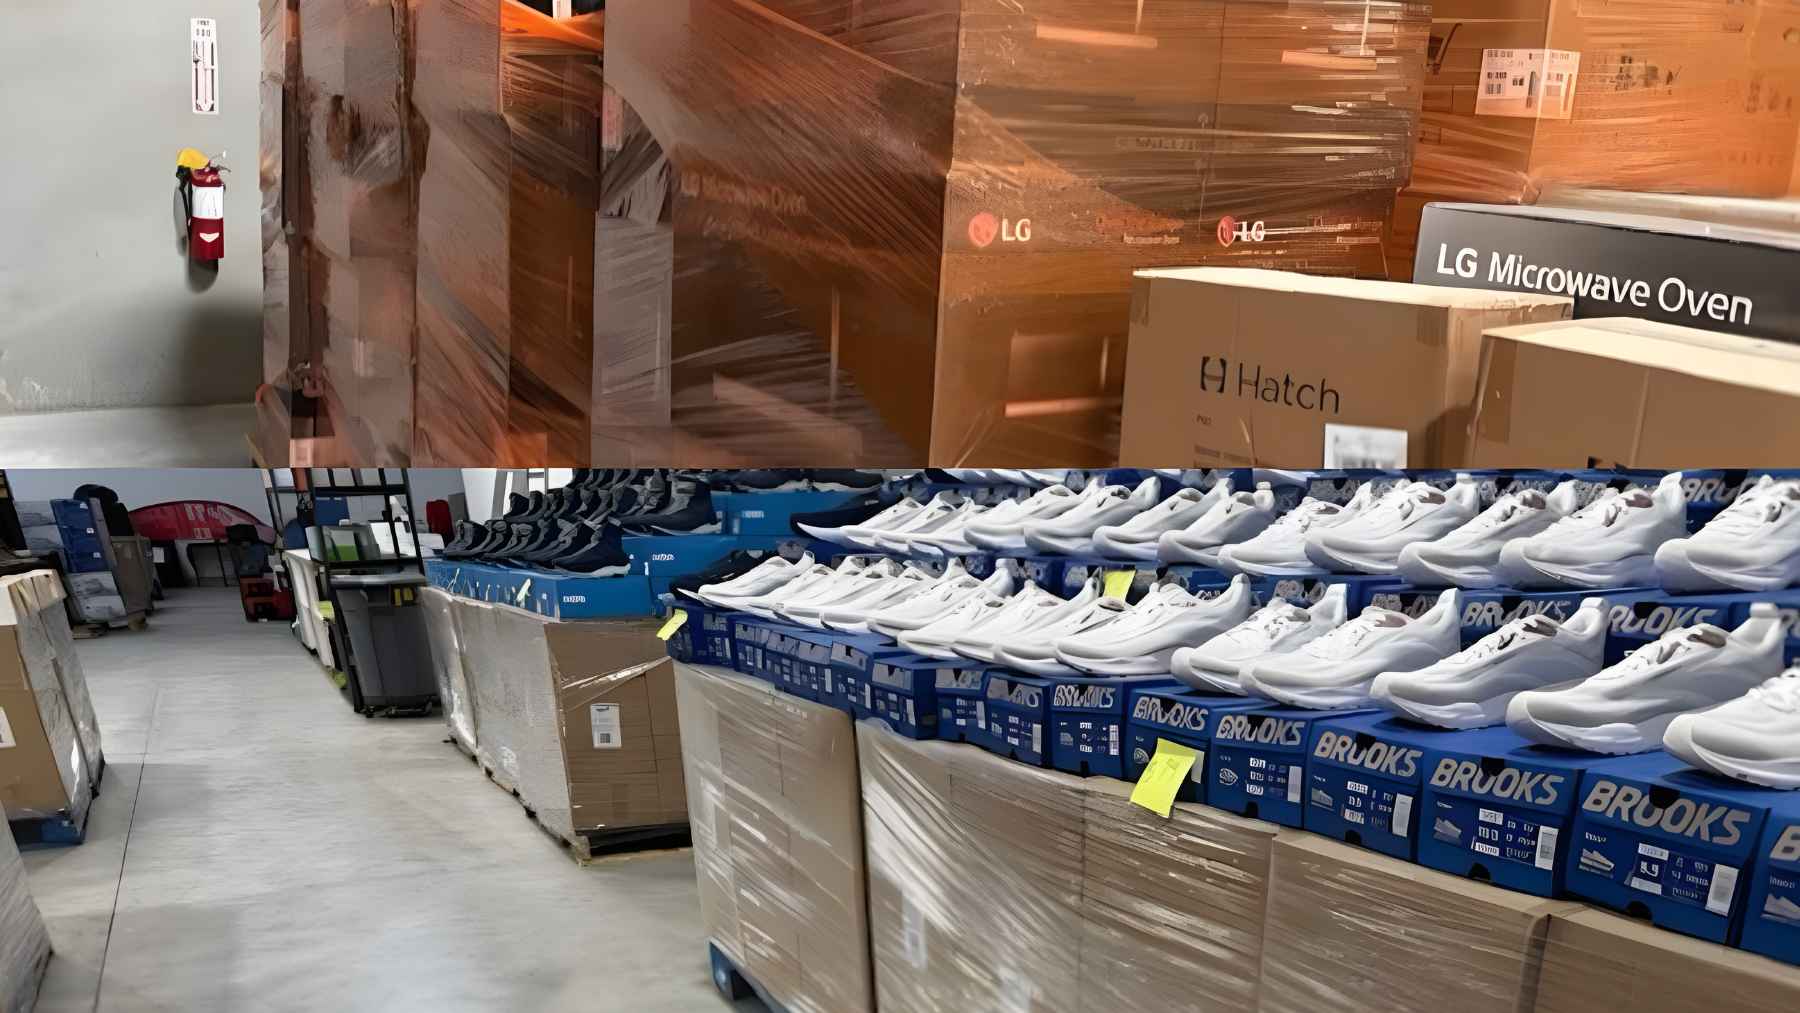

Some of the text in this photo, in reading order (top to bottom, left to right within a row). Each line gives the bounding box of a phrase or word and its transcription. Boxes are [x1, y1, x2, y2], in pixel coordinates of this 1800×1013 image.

[1001, 218, 1031, 242] LG
[1242, 220, 1265, 242] LG
[1436, 243, 1753, 325] LG Microwave Oven
[1238, 362, 1340, 414] Hatch
[1429, 757, 1565, 805] BROOKS
[1582, 779, 1751, 846] BROOKS
